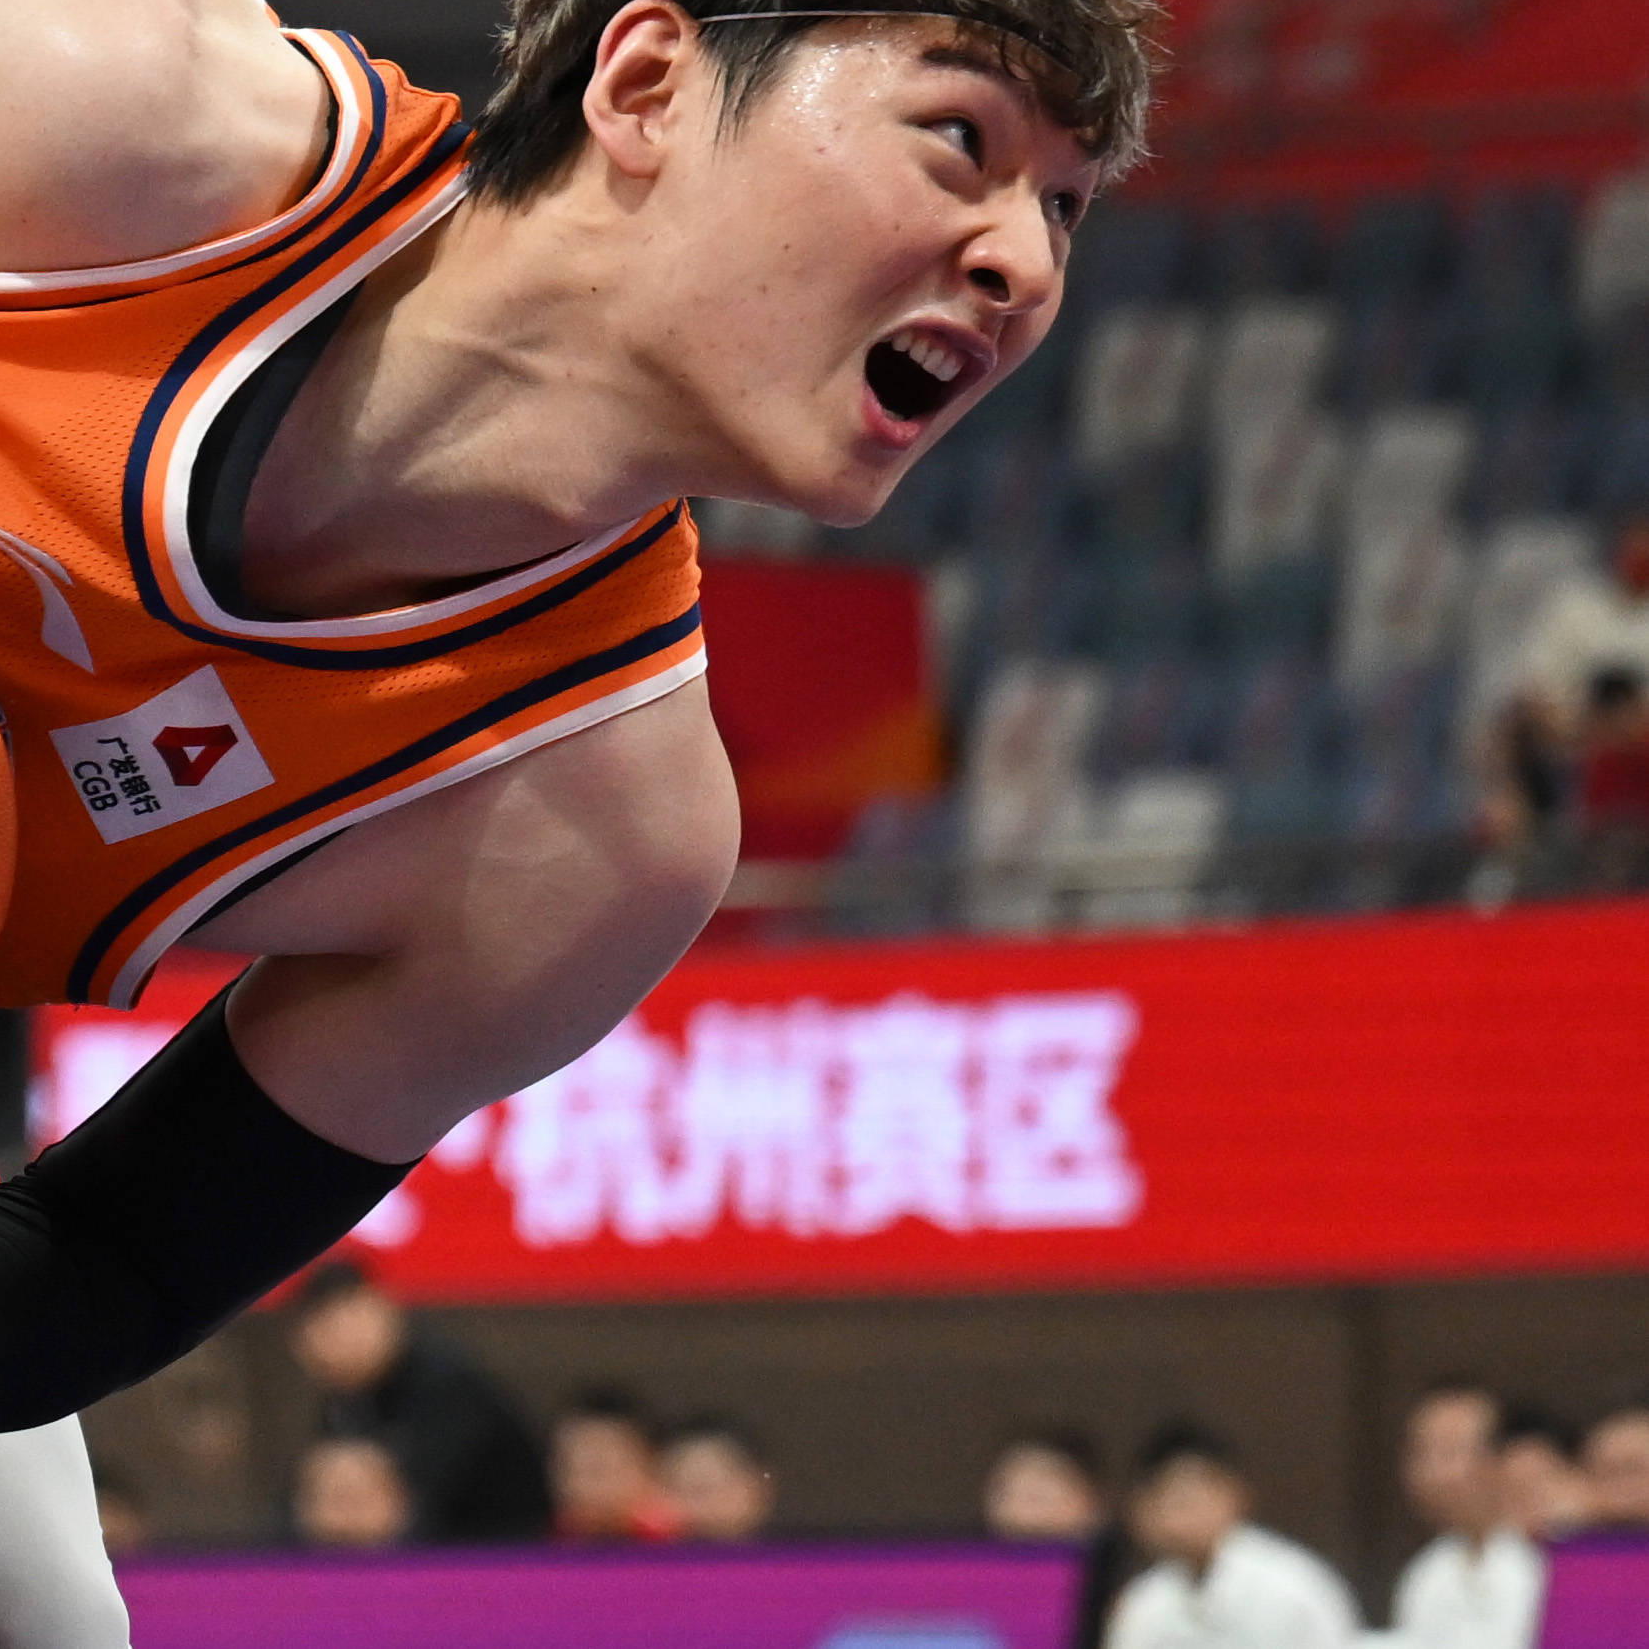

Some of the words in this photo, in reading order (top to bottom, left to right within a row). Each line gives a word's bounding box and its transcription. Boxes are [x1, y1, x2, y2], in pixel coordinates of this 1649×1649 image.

[73, 760, 119, 812] CGB
[97, 737, 161, 816] 广发银行
